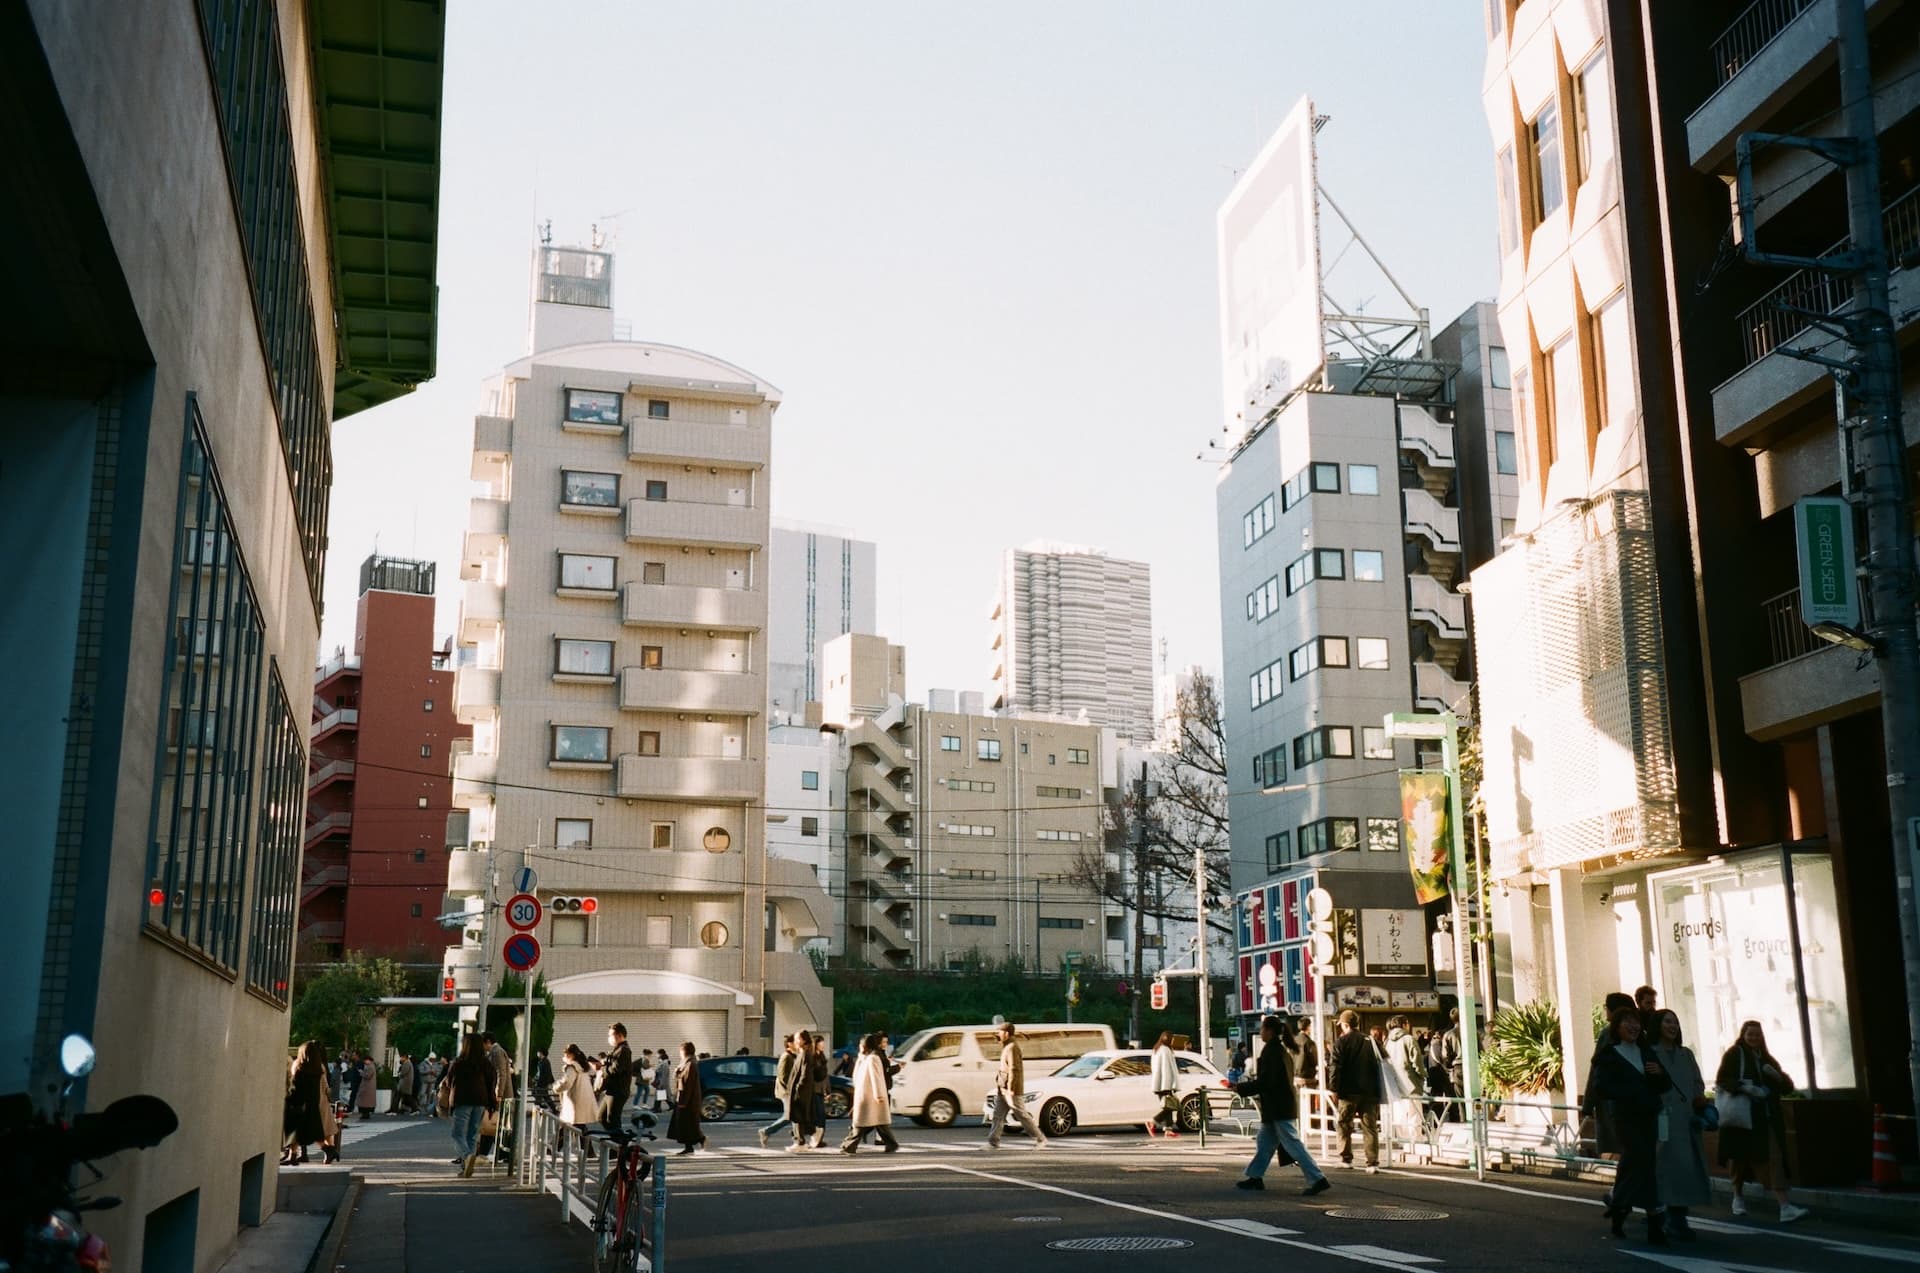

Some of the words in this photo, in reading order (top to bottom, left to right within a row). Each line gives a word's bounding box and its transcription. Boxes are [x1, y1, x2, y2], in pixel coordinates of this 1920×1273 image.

[1818, 523, 1833, 566] GREEN
[1821, 569, 1836, 601] SEED
[514, 904, 534, 921] 30
[1673, 917, 1722, 943] grounds
